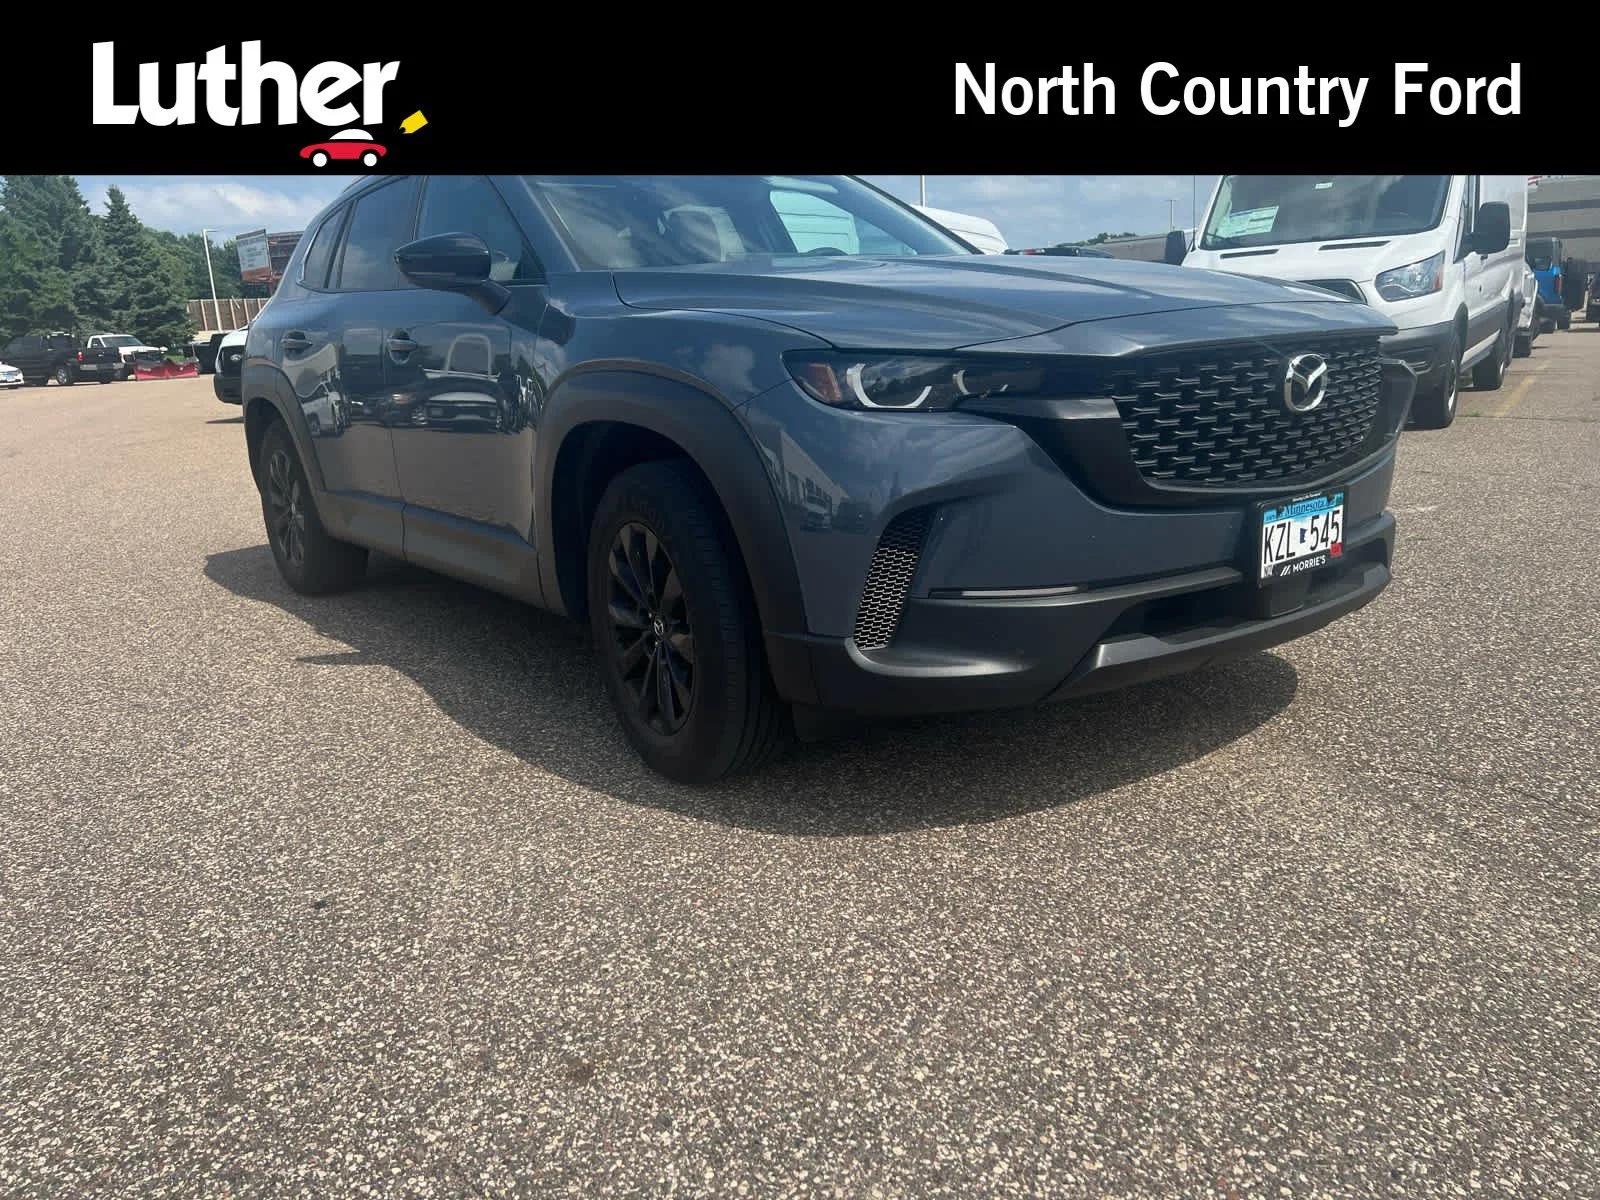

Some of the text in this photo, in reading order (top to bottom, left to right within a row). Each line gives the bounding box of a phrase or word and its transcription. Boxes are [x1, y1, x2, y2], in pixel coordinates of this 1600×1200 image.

[1286, 499, 1326, 516] Minnesota
[1263, 509, 1340, 564] KZL 545
[1292, 554, 1326, 573] MORRIE'S
